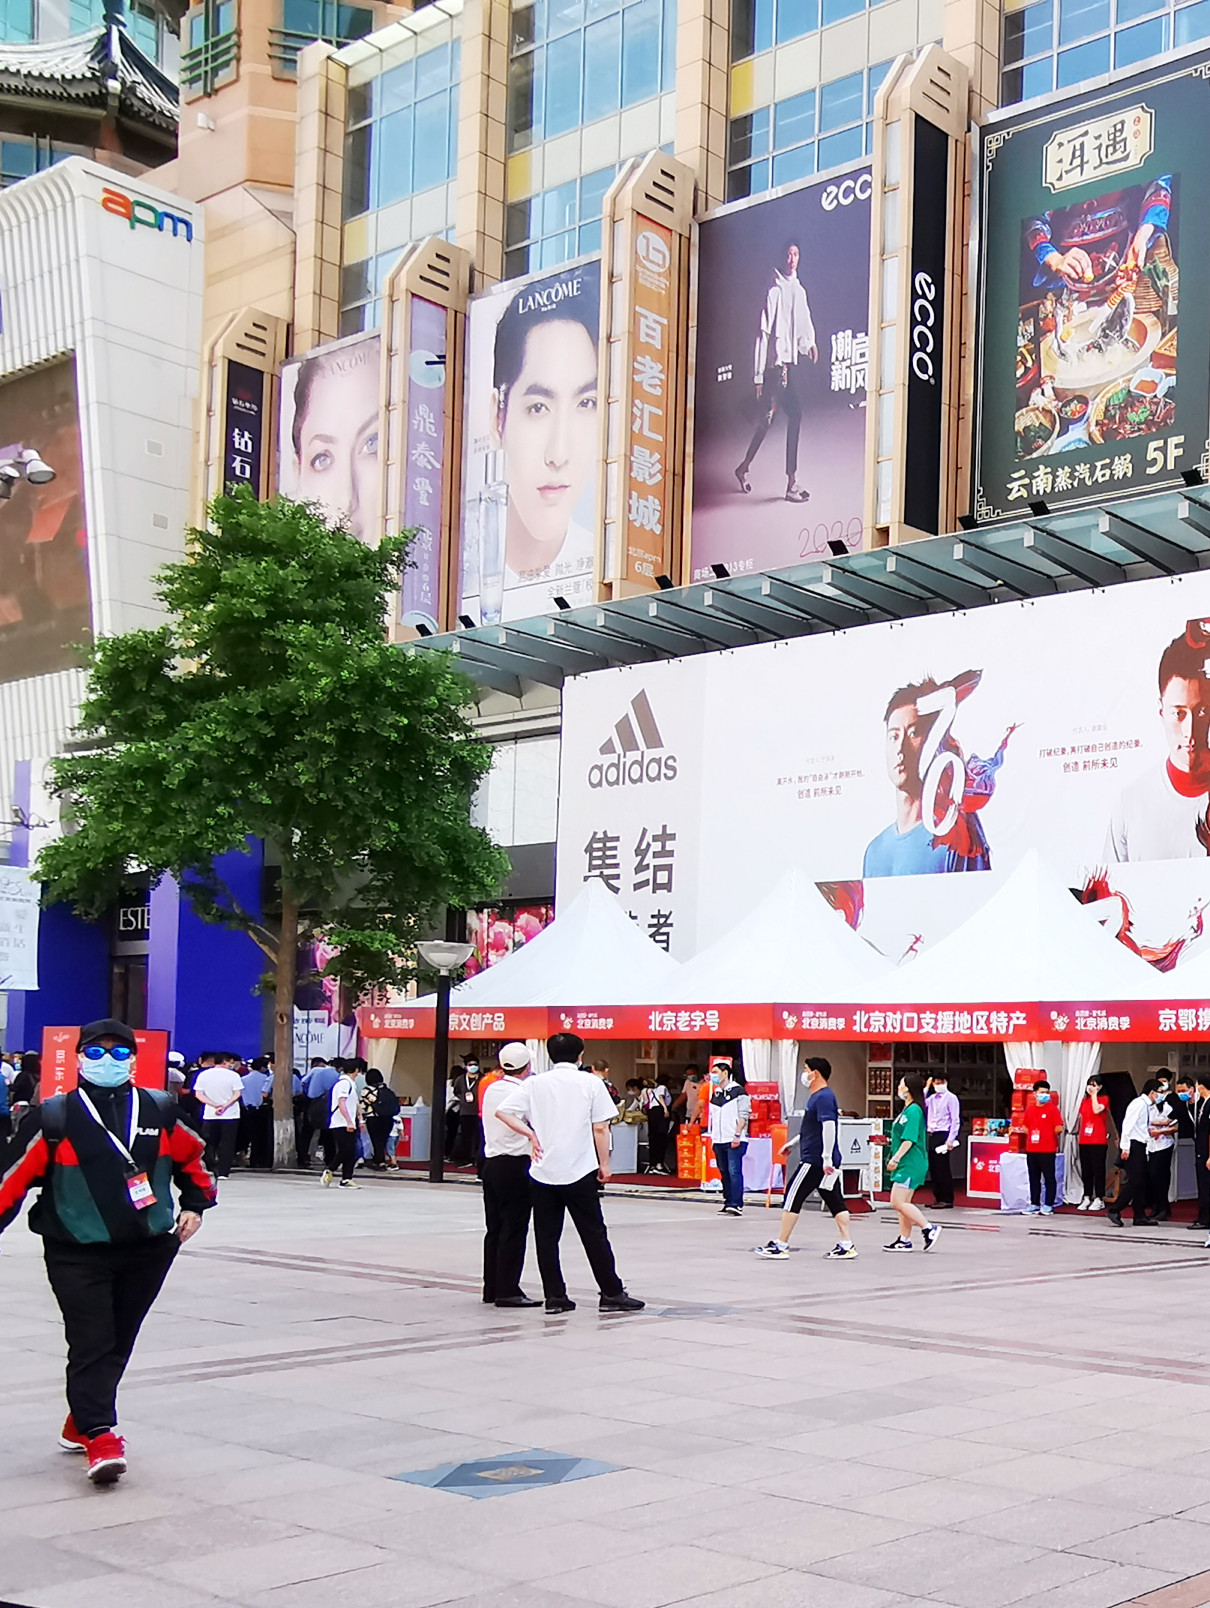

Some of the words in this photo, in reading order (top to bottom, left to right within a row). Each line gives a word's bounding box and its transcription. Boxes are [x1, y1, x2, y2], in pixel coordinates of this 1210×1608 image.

[102, 187, 193, 243] apm
[912, 272, 936, 381] ecco
[628, 305, 668, 536] 百老汇影城
[1006, 453, 1133, 501] 云南蒸汽石锅
[1146, 435, 1185, 475] 5F
[634, 561, 654, 578] 6层
[588, 750, 678, 789] adidas
[583, 825, 676, 895] 集结
[649, 1010, 720, 1032] 北京老字号
[852, 1010, 1028, 1035] 北京对口支援地区特产
[1075, 1016, 1131, 1031] 北京消费季
